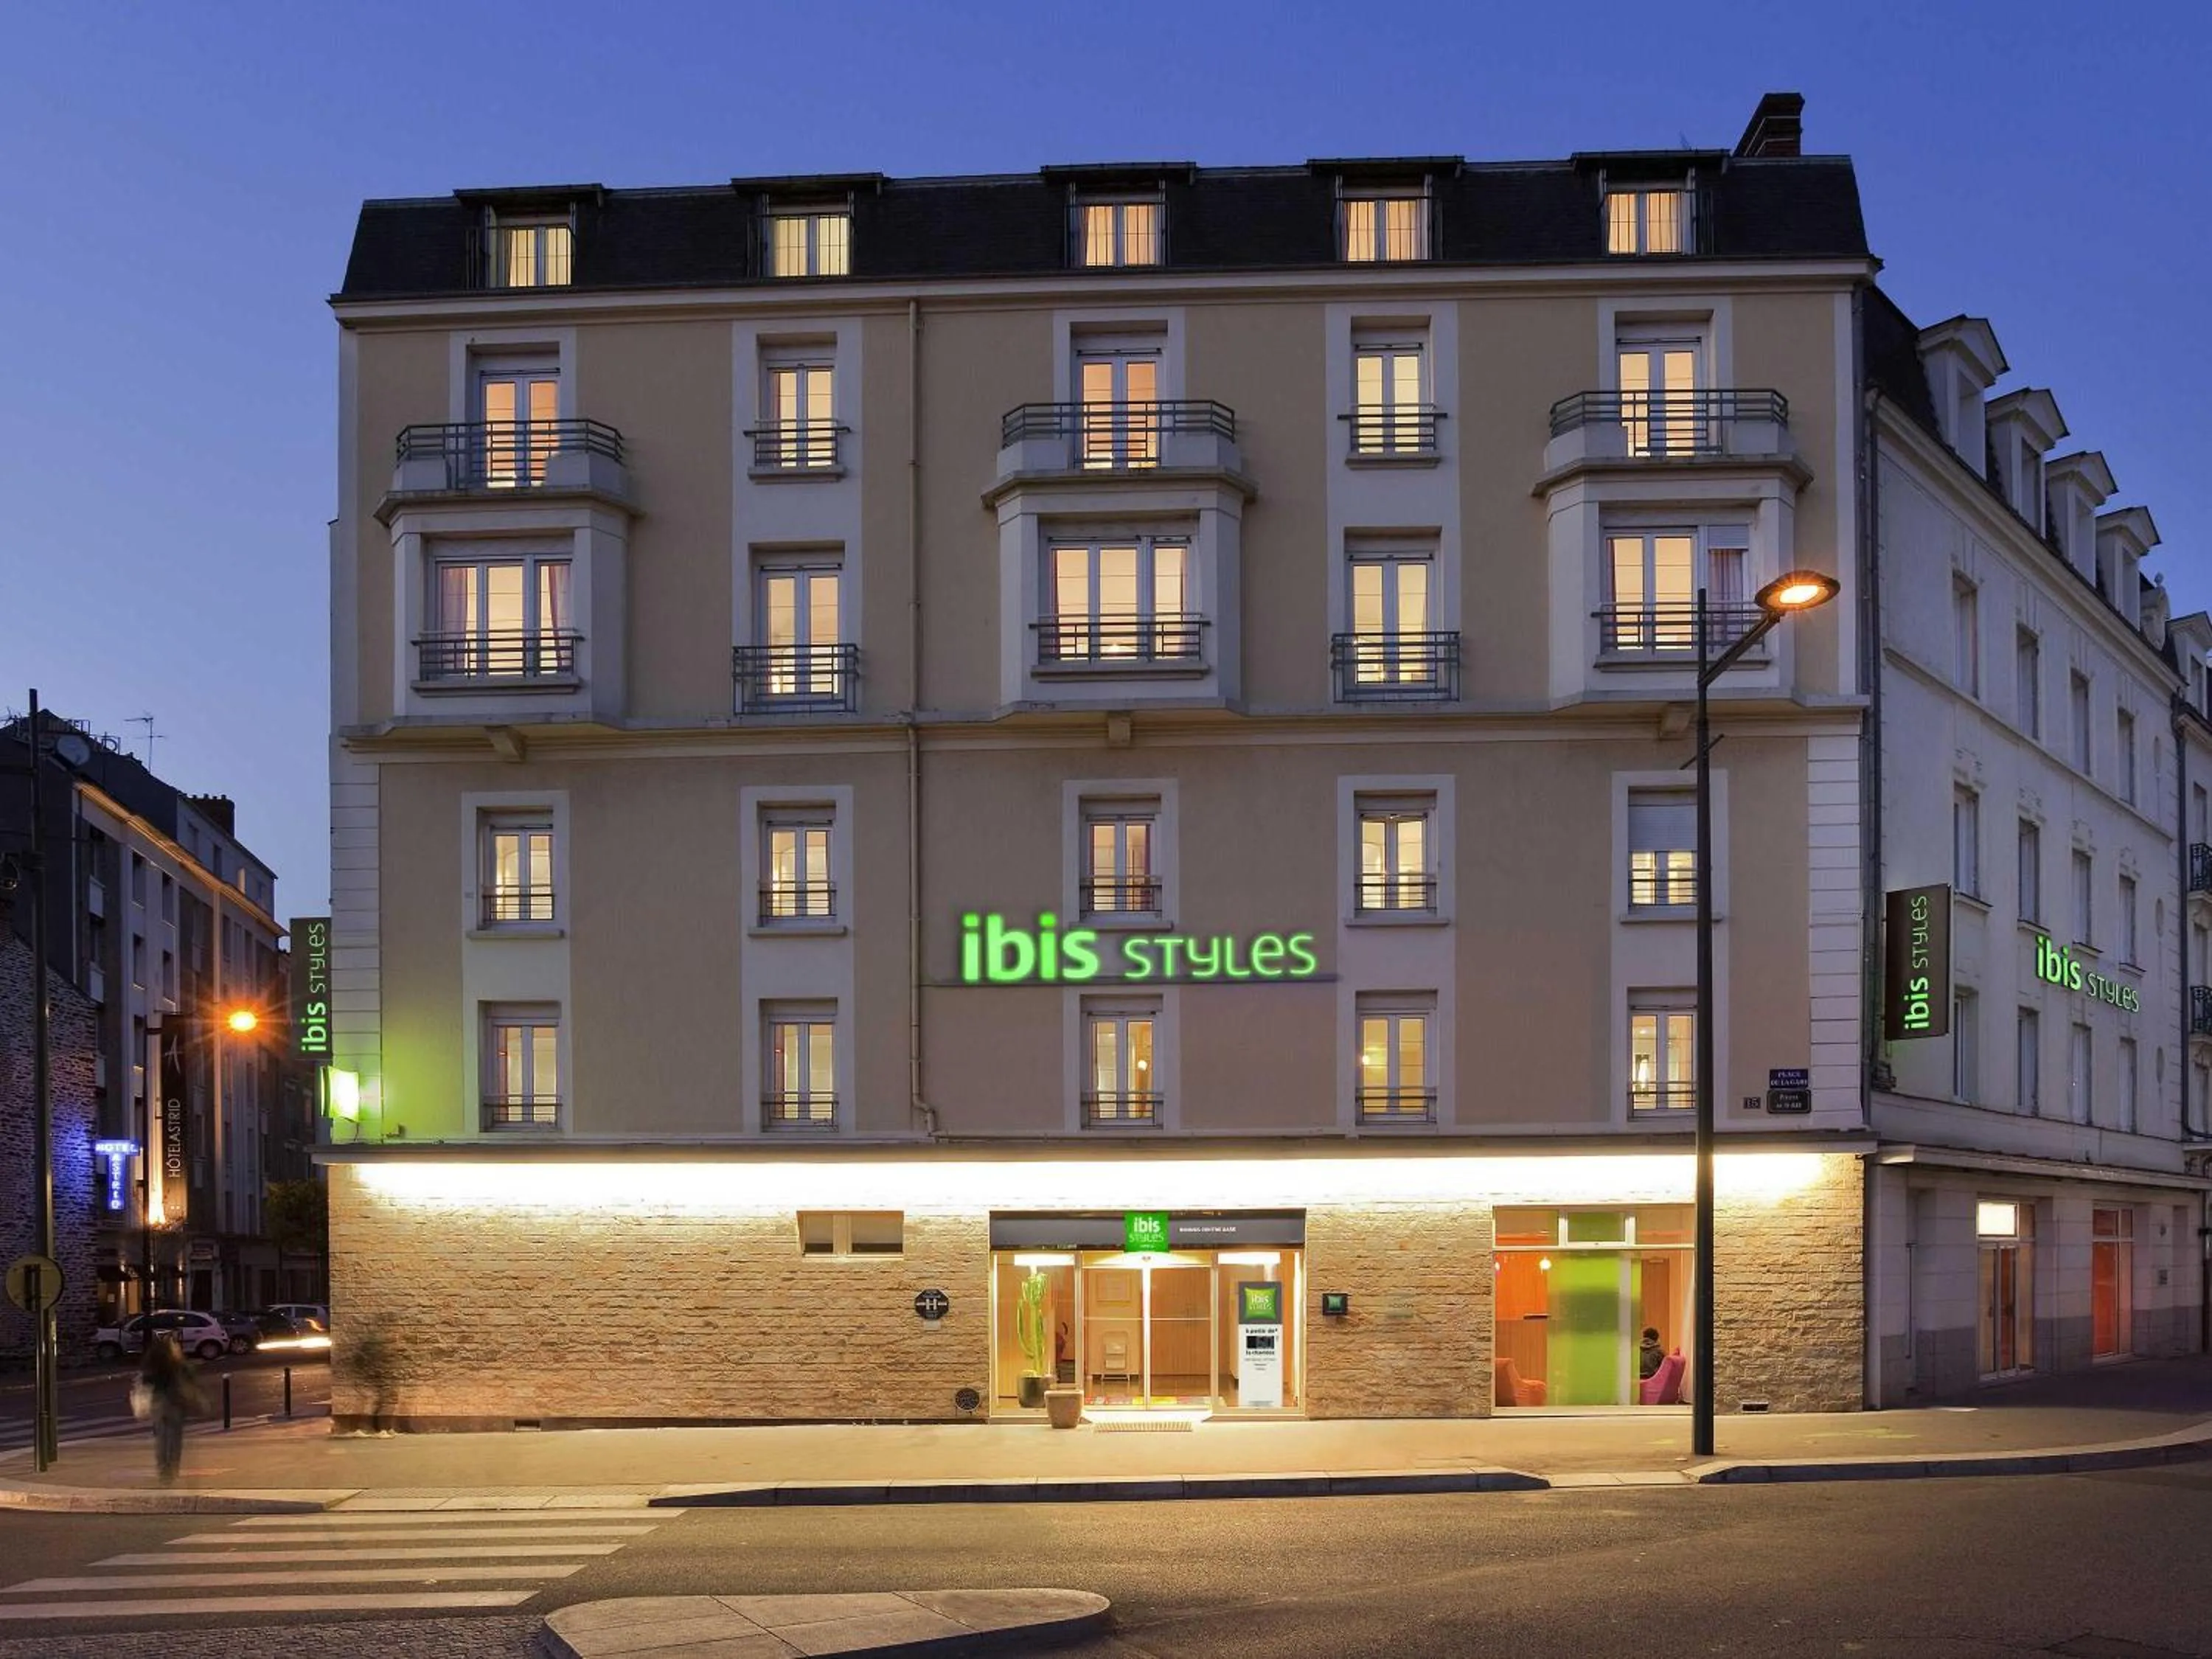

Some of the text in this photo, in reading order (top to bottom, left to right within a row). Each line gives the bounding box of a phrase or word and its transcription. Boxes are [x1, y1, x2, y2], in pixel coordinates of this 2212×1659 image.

[961, 912, 1100, 982] ibis
[2036, 934, 2082, 991] ibis
[301, 1002, 327, 1051] ibis
[1904, 977, 1930, 1030] ibis
[1134, 1217, 1161, 1233] ibis
